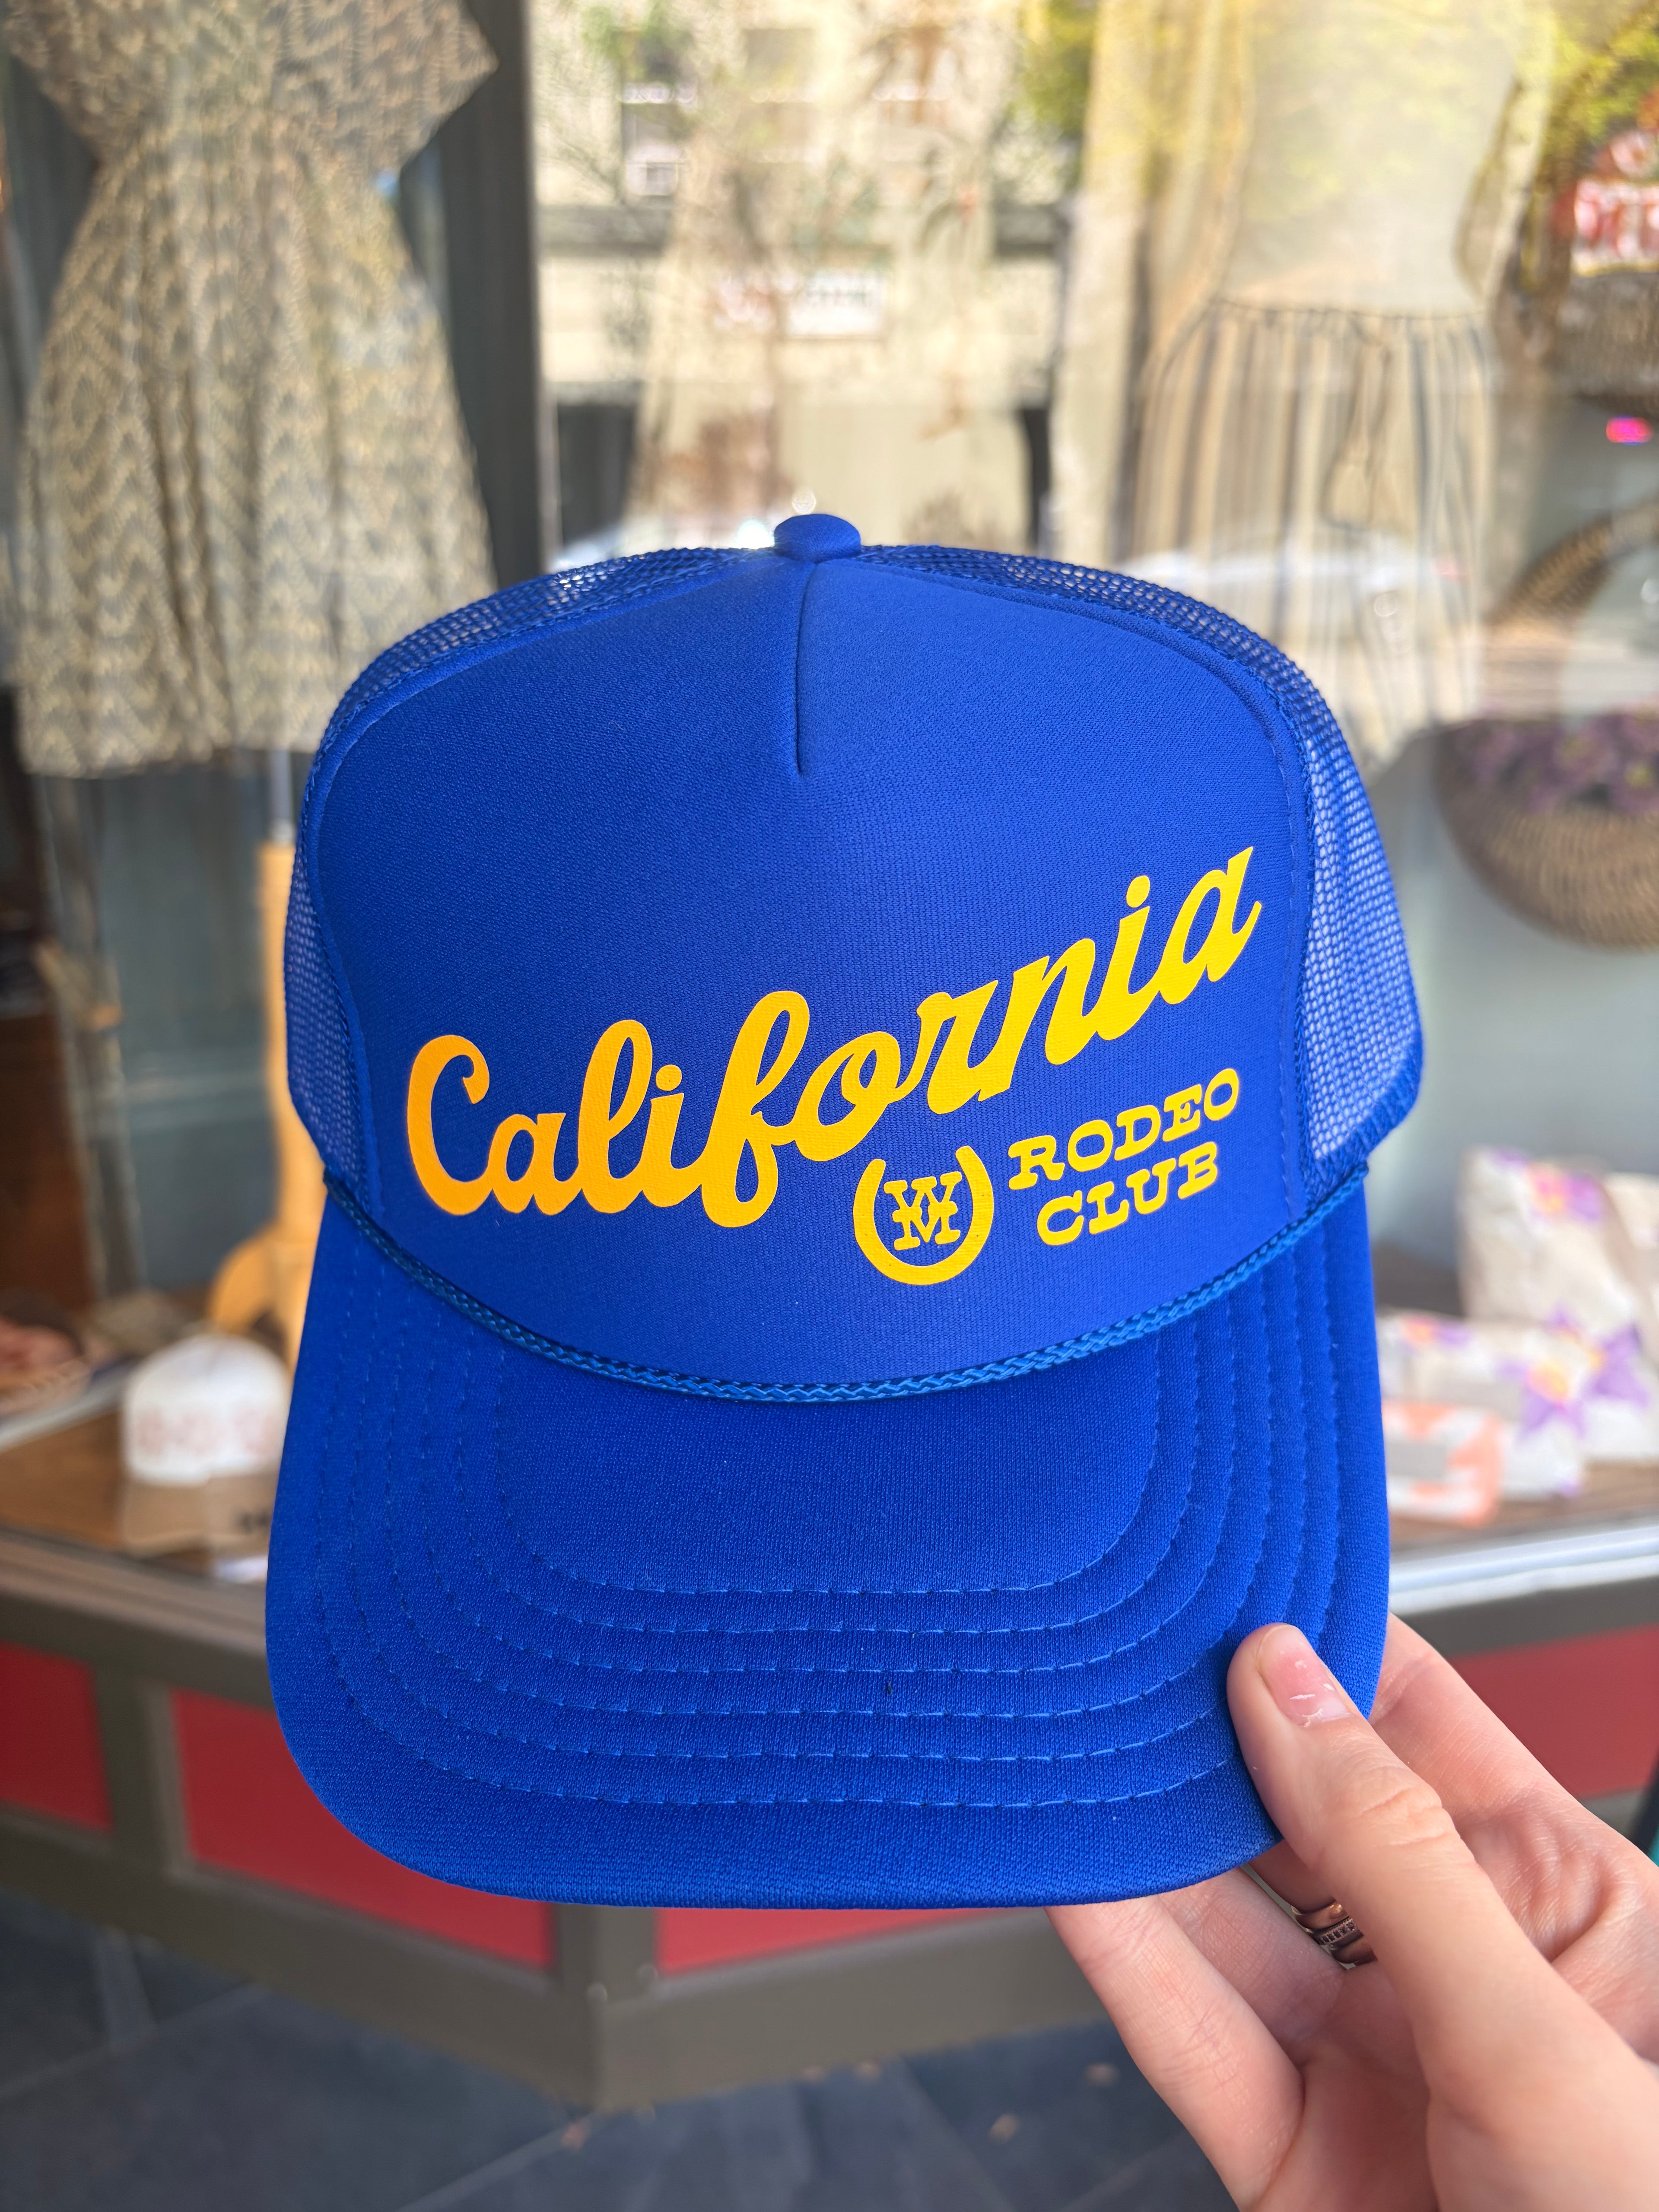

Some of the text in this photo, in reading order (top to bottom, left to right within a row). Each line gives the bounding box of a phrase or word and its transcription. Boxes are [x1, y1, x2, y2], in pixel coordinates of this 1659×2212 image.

[406, 847, 1261, 1228] California
[1008, 1069, 1239, 1190] RODEO
[1037, 1143, 1217, 1245] CLUB
